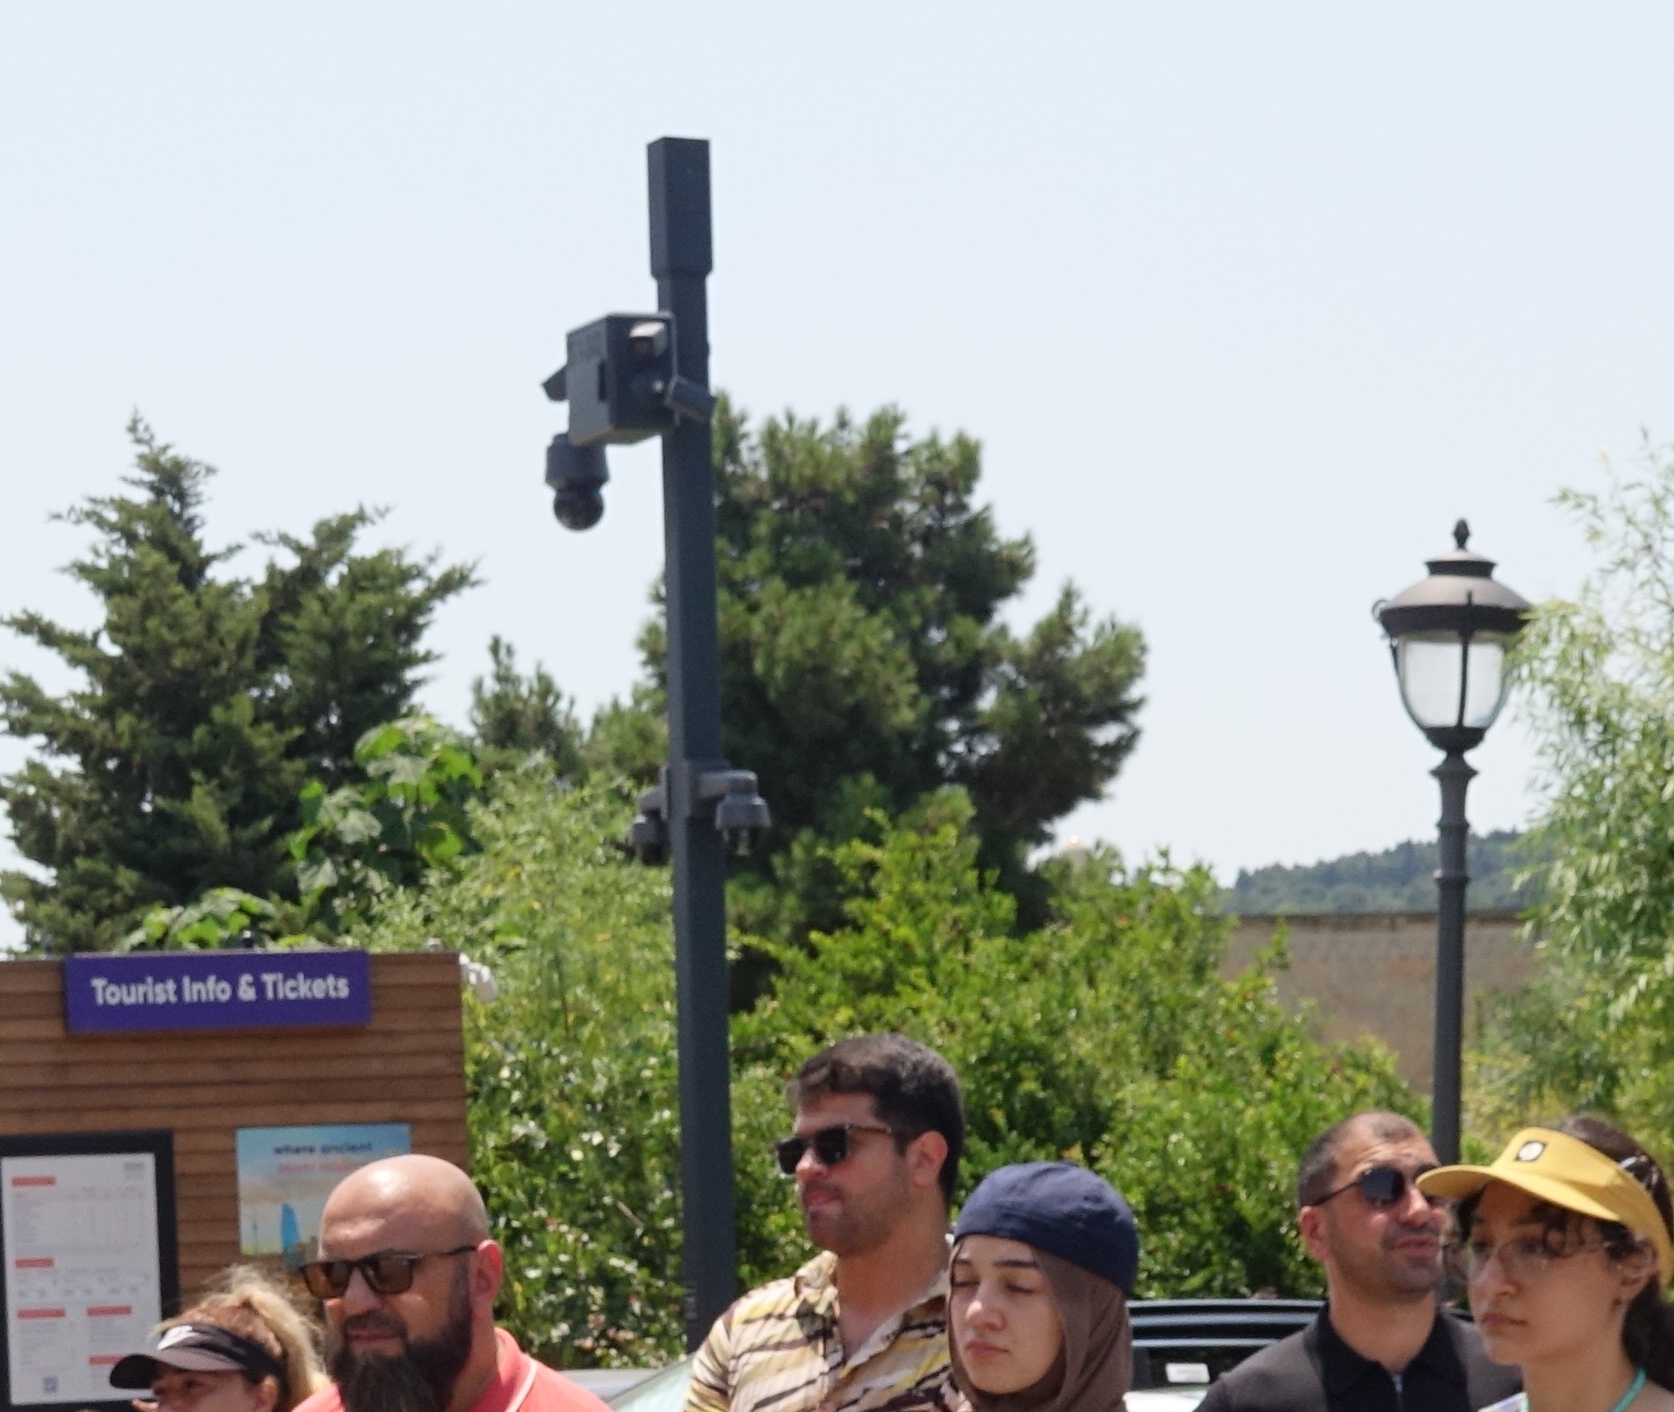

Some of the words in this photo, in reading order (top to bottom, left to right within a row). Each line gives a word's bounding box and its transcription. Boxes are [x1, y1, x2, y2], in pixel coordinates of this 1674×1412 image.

[90, 976, 178, 1006] Tourist
[181, 975, 232, 1002] Info
[237, 973, 256, 1001] &
[259, 972, 350, 1000] Tickets
